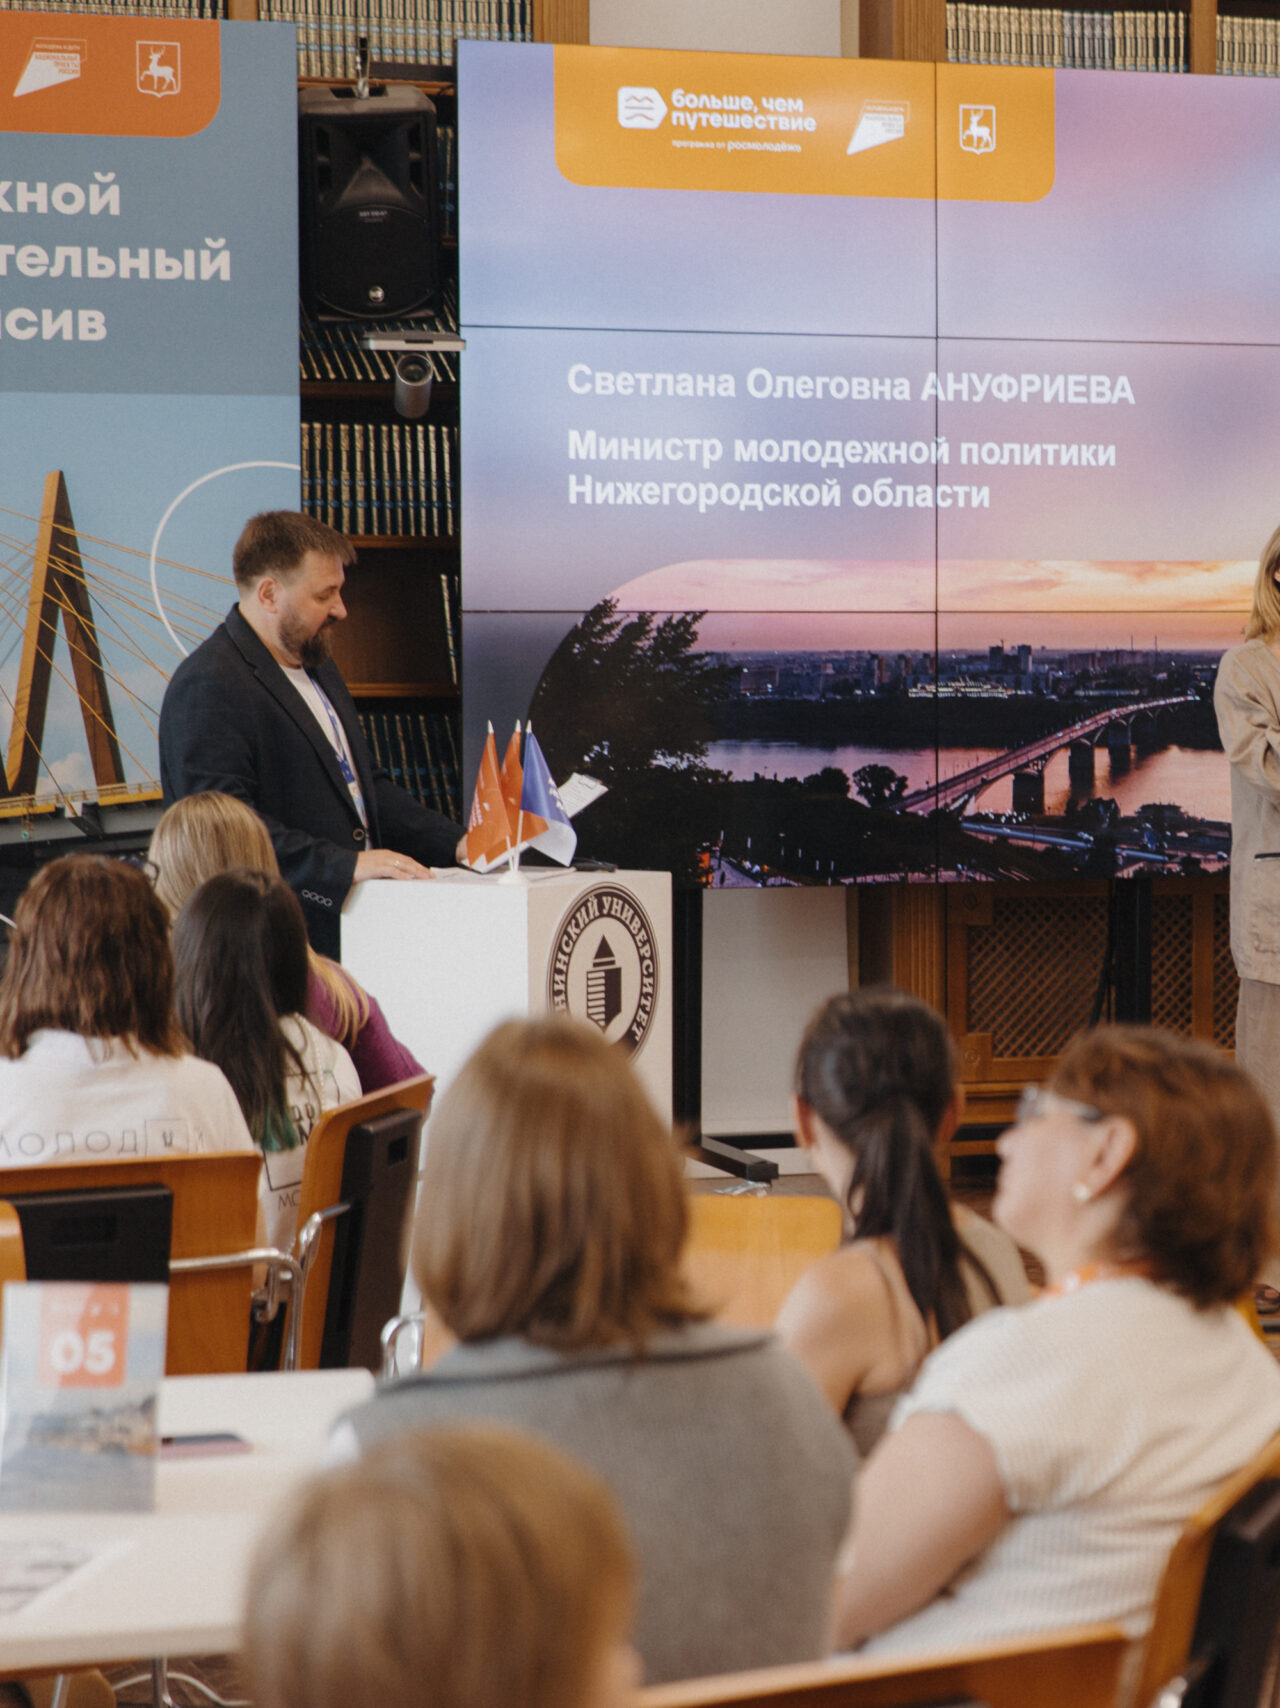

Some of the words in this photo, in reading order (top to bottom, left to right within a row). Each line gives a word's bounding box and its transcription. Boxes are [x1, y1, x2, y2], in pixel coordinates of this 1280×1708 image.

[671, 88, 758, 113] больше,
[762, 97, 804, 113] чем
[671, 111, 817, 132] путешествие
[0, 307, 108, 341] сив
[567, 364, 736, 398] Светлана
[746, 367, 911, 402] Олеговна
[920, 371, 1136, 405] АНУФРИЕВА
[567, 430, 723, 469] Министр
[734, 436, 950, 468] молодежной
[960, 439, 1117, 467] политики
[567, 474, 842, 513] Нижегородской
[852, 477, 990, 509] области
[601, 896, 655, 1042] УНИВЕРСИТЕТ
[51, 1331, 116, 1375] 05
